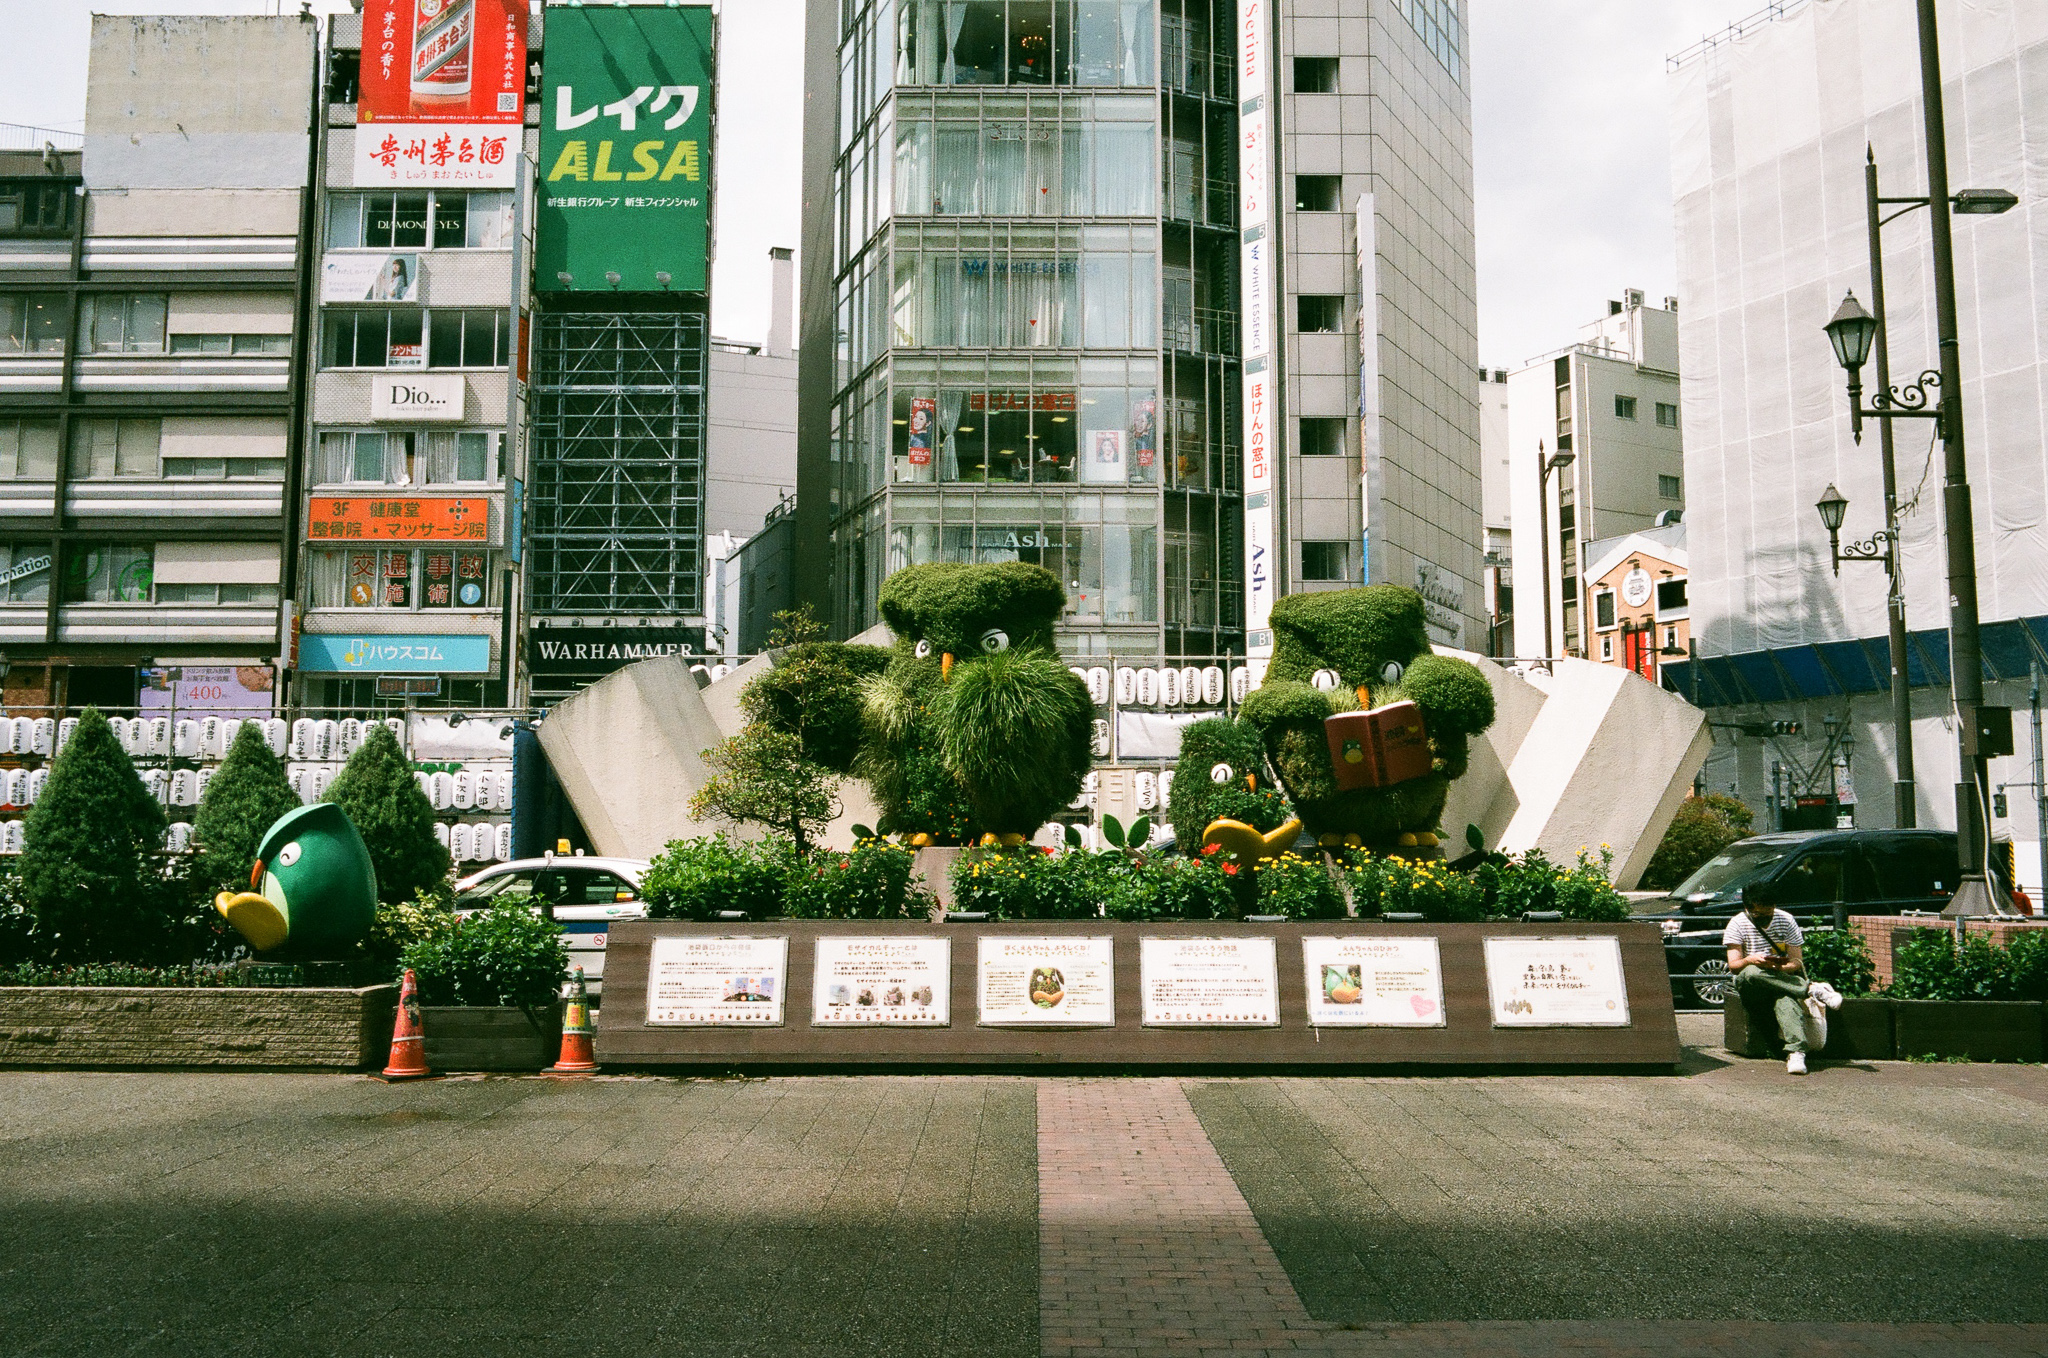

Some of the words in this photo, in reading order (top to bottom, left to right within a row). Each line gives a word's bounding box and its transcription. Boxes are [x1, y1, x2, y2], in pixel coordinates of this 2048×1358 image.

[1245, 3, 1258, 77] Serina
[503, 14, 516, 89] 日和商事株式会社
[556, 86, 699, 131] レイク
[1256, 95, 1264, 109] 6
[369, 131, 508, 168] 貴州茅台酒
[547, 141, 700, 182] ALSA
[1244, 131, 1256, 212] さくら
[547, 197, 620, 208] 新生銀行グループ
[624, 197, 699, 208] 新生フィナンシャル
[1258, 225, 1265, 238] 5
[1252, 264, 1260, 300] WHITE
[1252, 303, 1261, 351] ESSENCE
[1260, 357, 1267, 370] 4
[391, 385, 447, 405] Dio...
[970, 393, 1076, 411] ほけんの窓口
[1251, 383, 1264, 479] ほけんの窓口
[332, 501, 350, 517] 3F
[370, 501, 421, 518] 健康堂
[1262, 494, 1269, 506] 3
[1003, 531, 1051, 548] Ash
[352, 554, 484, 579] 交通事故
[1253, 544, 1266, 592] Ash
[385, 584, 449, 604] 施術
[1259, 632, 1271, 646] B1
[370, 645, 444, 660] ハウスコム
[538, 641, 692, 660] WARHAMMER
[189, 685, 222, 700] 400
[456, 774, 467, 802] 小次郎
[478, 775, 490, 806] 小次郎
